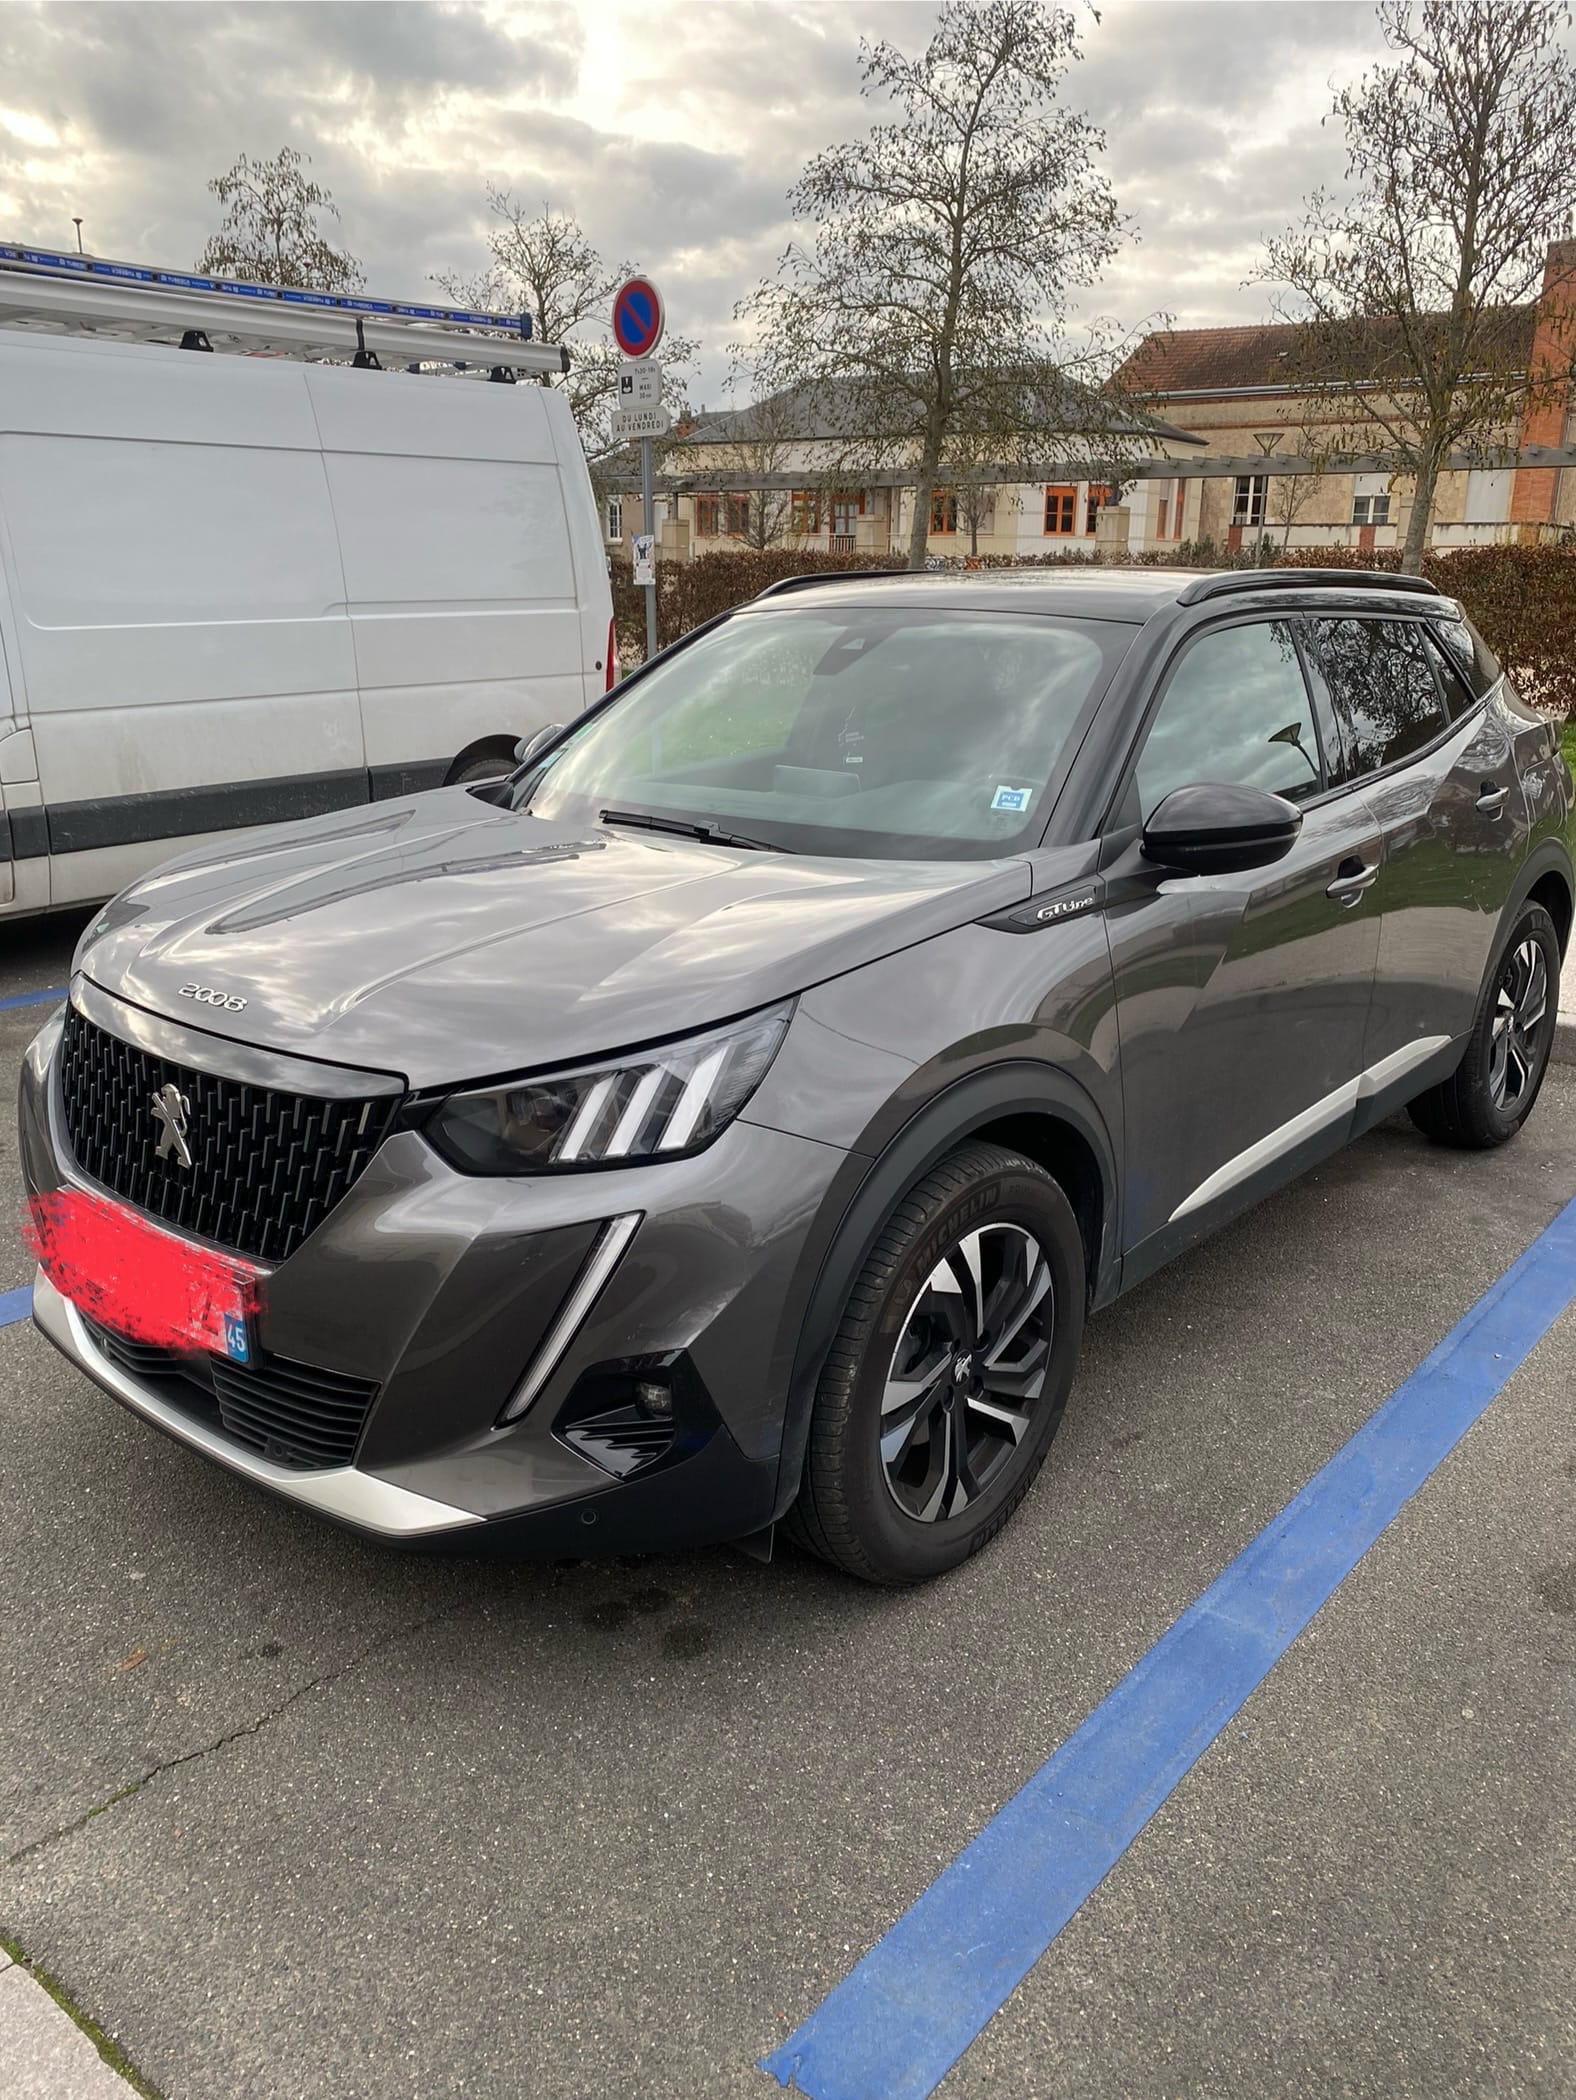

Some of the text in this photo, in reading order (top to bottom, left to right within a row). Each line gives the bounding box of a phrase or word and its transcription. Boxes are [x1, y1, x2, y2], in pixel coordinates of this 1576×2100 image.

[616, 420, 664, 432] AU VENDREDI
[622, 412, 656, 423] DU LUNDI
[177, 982, 249, 1012] 2008
[914, 1185, 999, 1275] MICHELIN
[227, 1324, 246, 1352] 45
